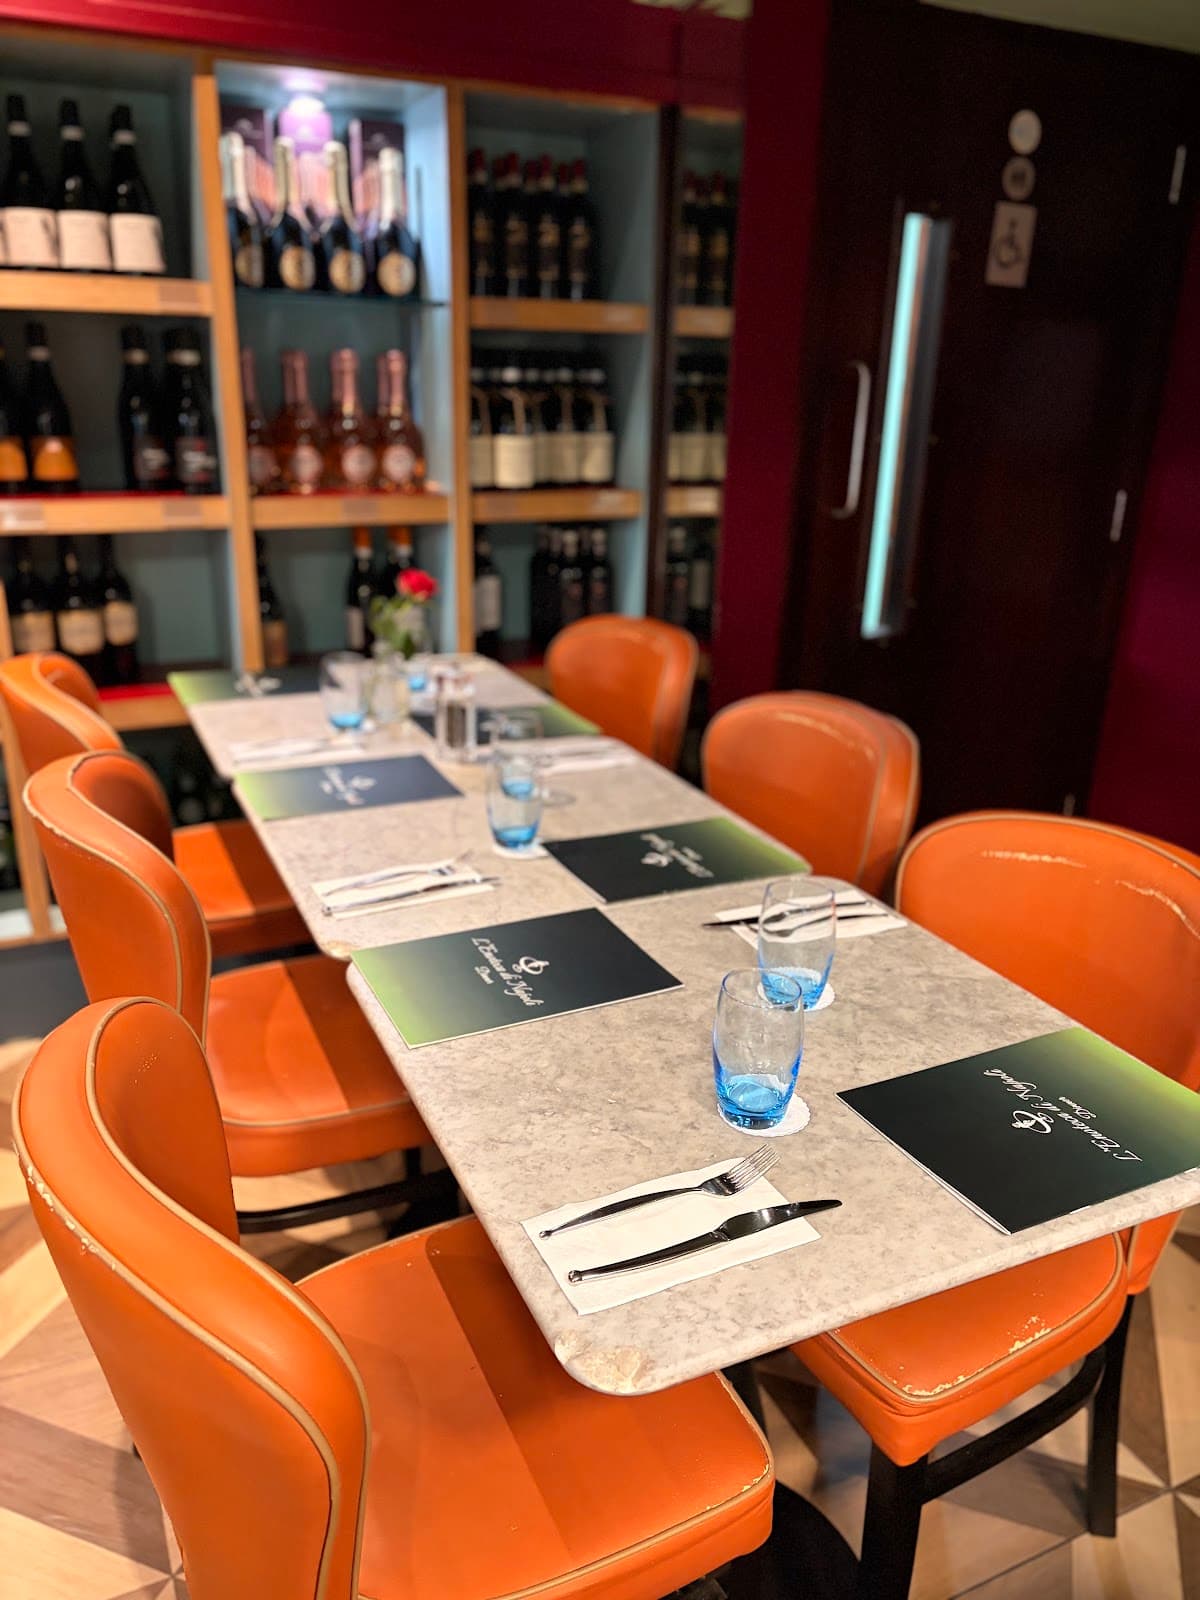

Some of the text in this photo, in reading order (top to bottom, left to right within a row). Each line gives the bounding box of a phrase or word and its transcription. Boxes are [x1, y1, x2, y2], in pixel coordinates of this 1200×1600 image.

[983, 1068, 1143, 1162] L'Enoteca di Napoli
[1058, 1096, 1097, 1120] Dinner
